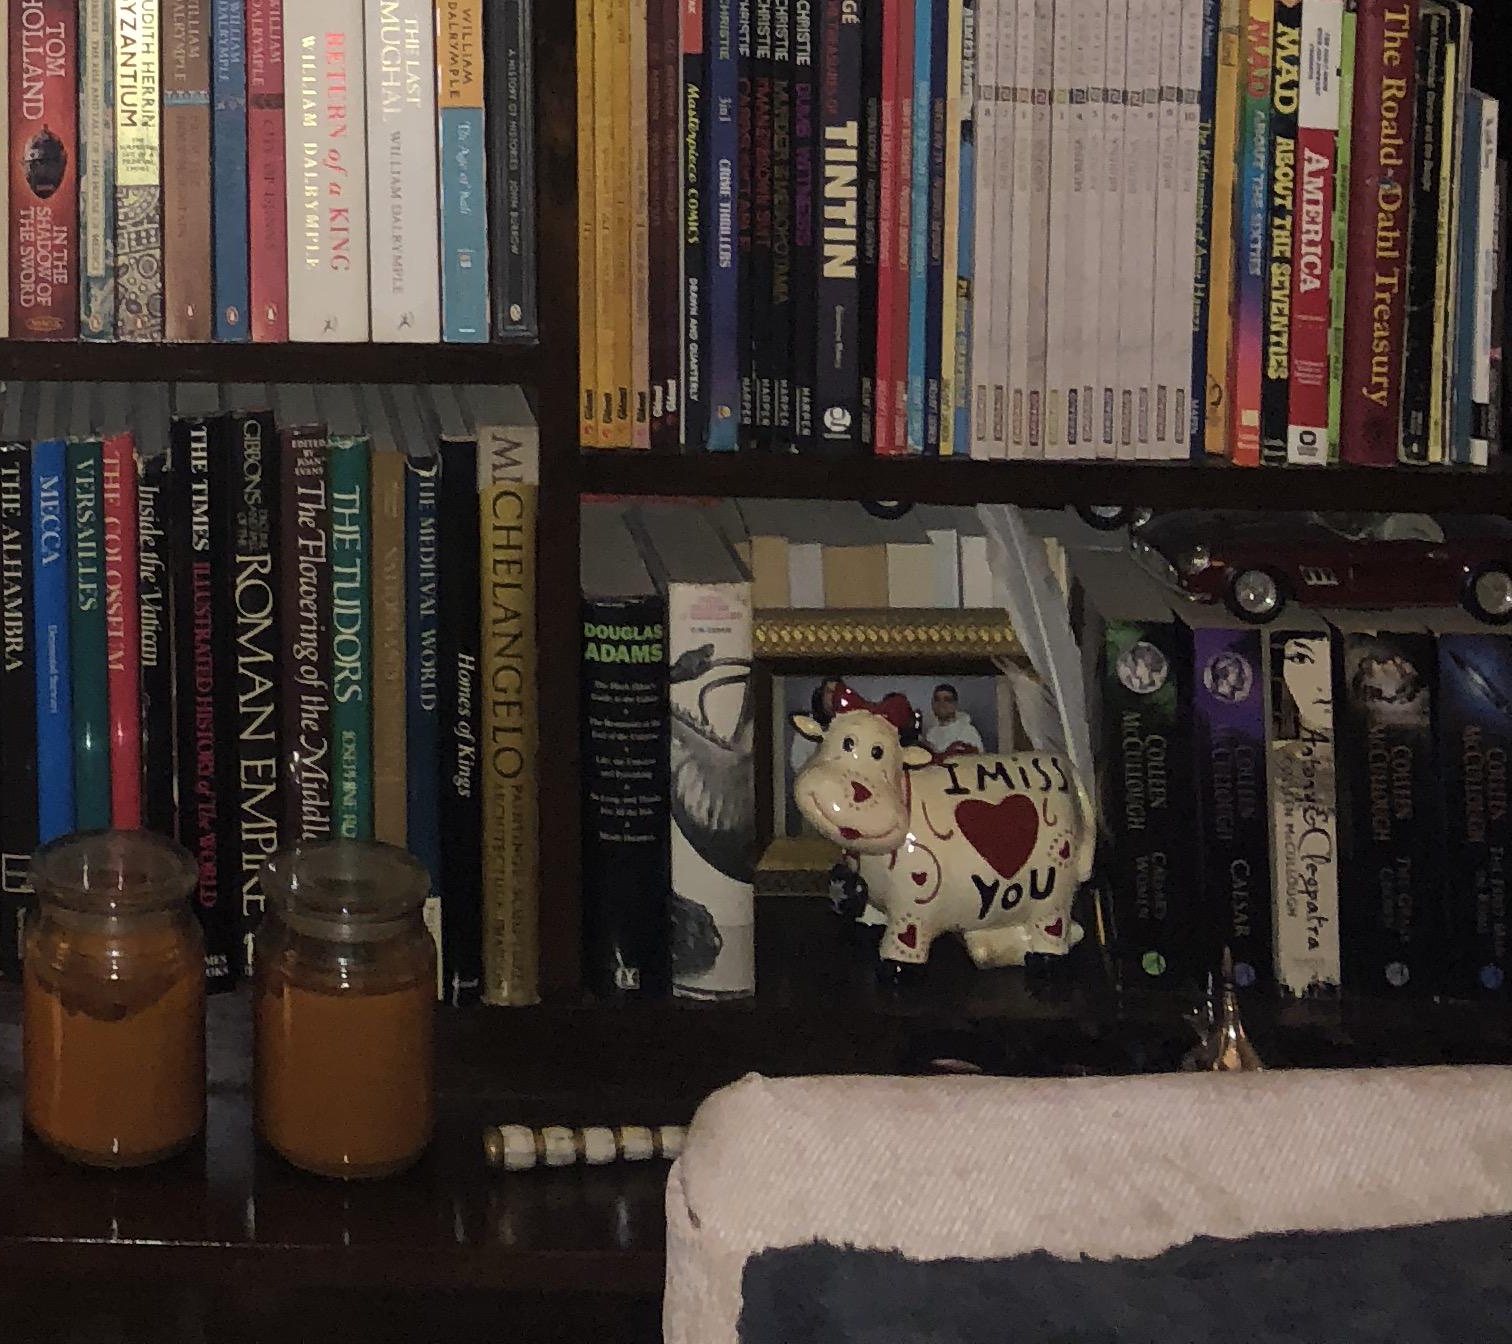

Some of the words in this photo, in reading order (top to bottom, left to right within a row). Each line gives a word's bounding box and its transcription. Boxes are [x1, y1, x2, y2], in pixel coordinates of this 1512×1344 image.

[46, 22, 65, 79] TOM
[1274, 22, 1301, 114] MAD
[1382, 6, 1410, 67] The
[1378, 78, 1407, 167] Roald
[823, 120, 860, 280] TINTIN
[1300, 148, 1330, 294] AMERICA
[1376, 180, 1403, 264] Dahl
[1360, 272, 1400, 407] Treasury
[40, 476, 63, 566] MECCA
[74, 458, 98, 611] VERSAILLES
[333, 486, 360, 552] THE
[236, 553, 274, 742] ROMAN
[333, 558, 362, 704] TUDORS
[490, 434, 528, 780] MICHELANGELO
[584, 623, 662, 640] DOUGLAS
[584, 644, 662, 663] ADAMS
[944, 764, 970, 795] I
